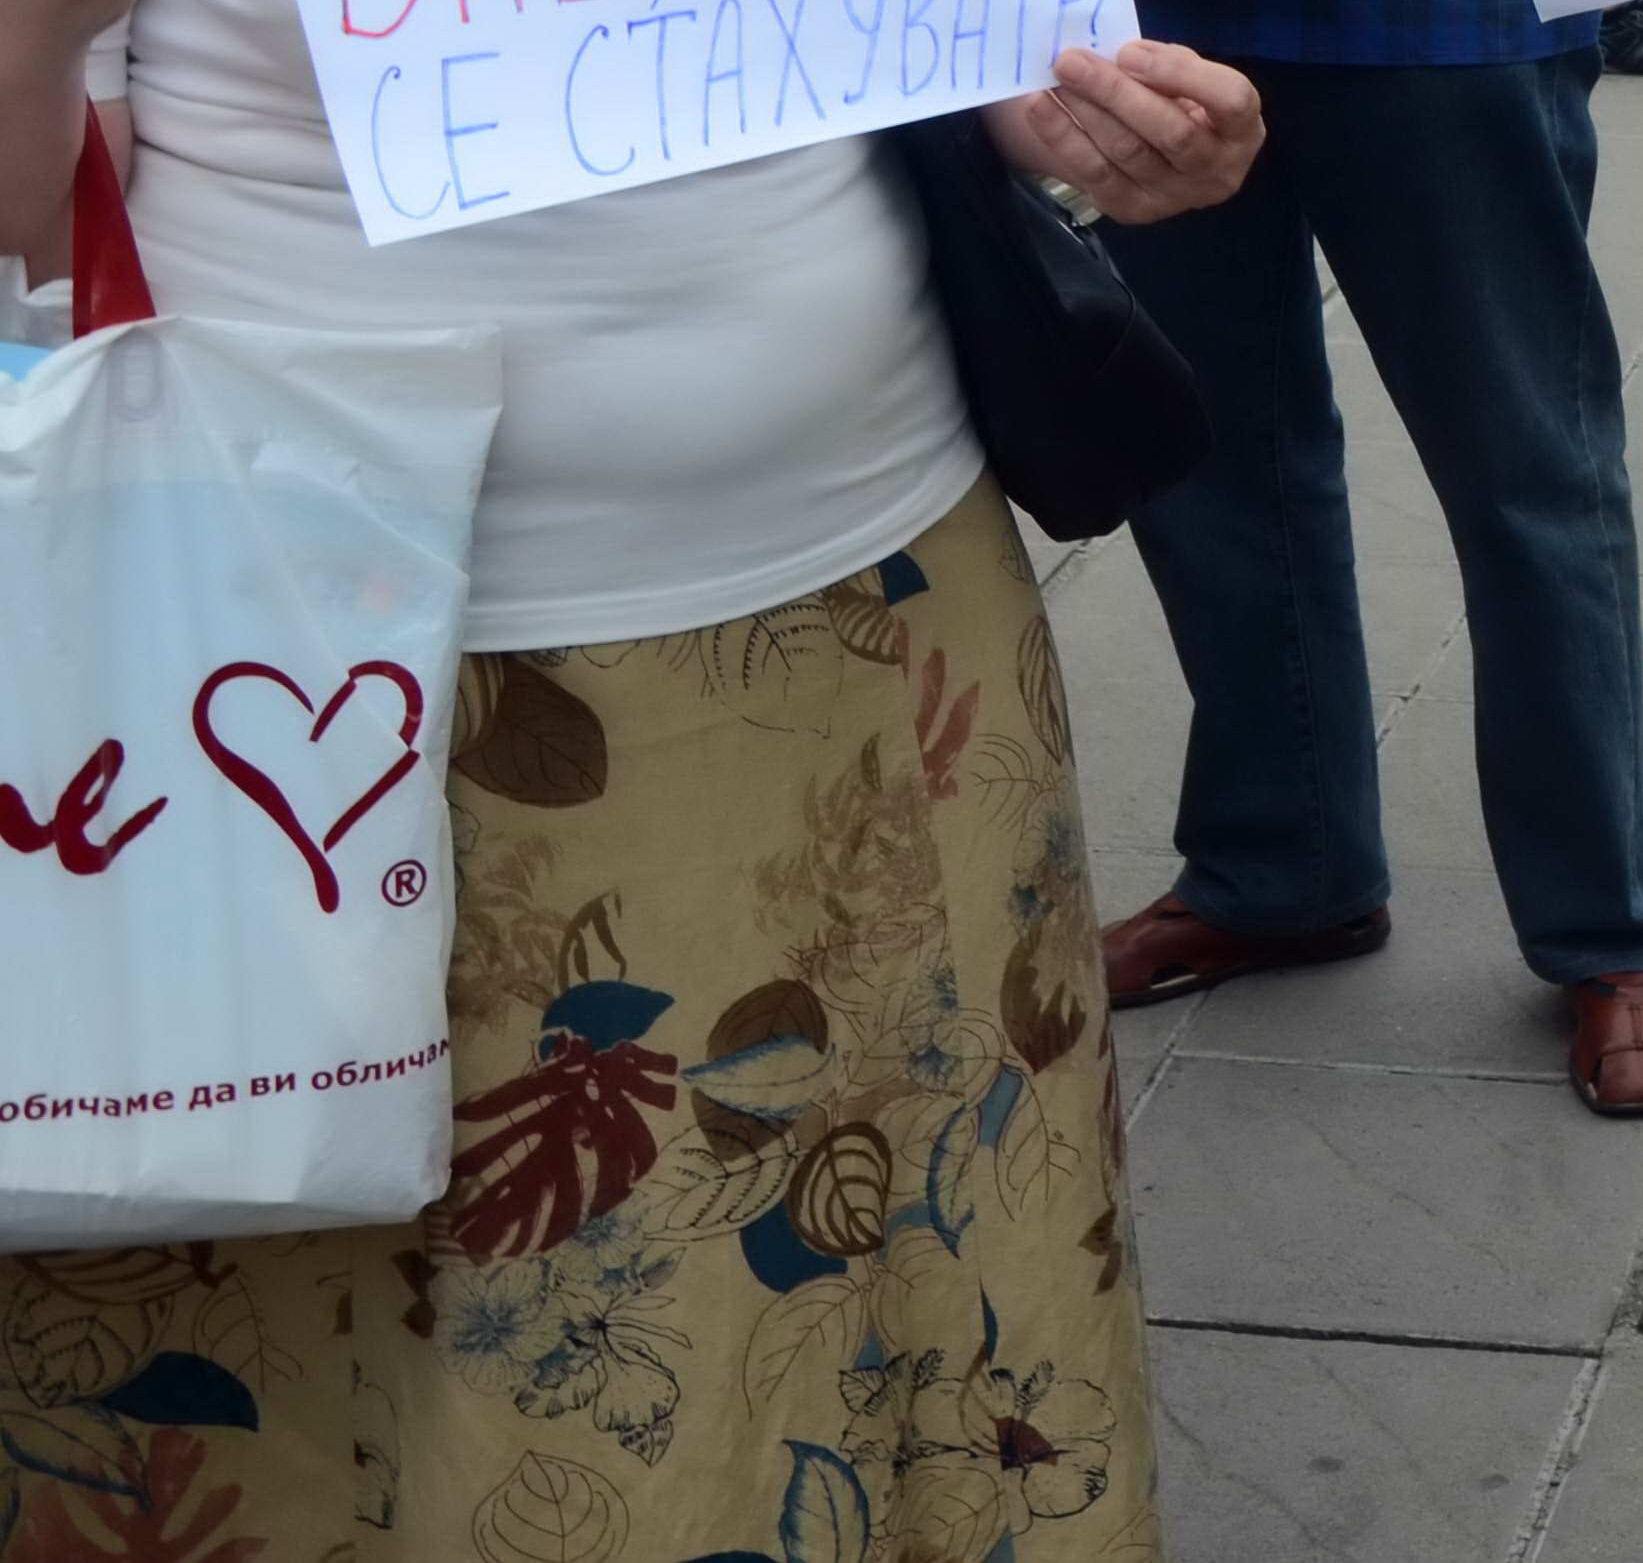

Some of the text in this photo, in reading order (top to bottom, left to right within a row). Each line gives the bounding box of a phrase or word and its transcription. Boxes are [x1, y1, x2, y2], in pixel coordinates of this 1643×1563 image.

[369, 51, 511, 220] СЕ
[0, 1090, 175, 1123] обичаме
[188, 1082, 237, 1111] да
[249, 1072, 297, 1097] ви
